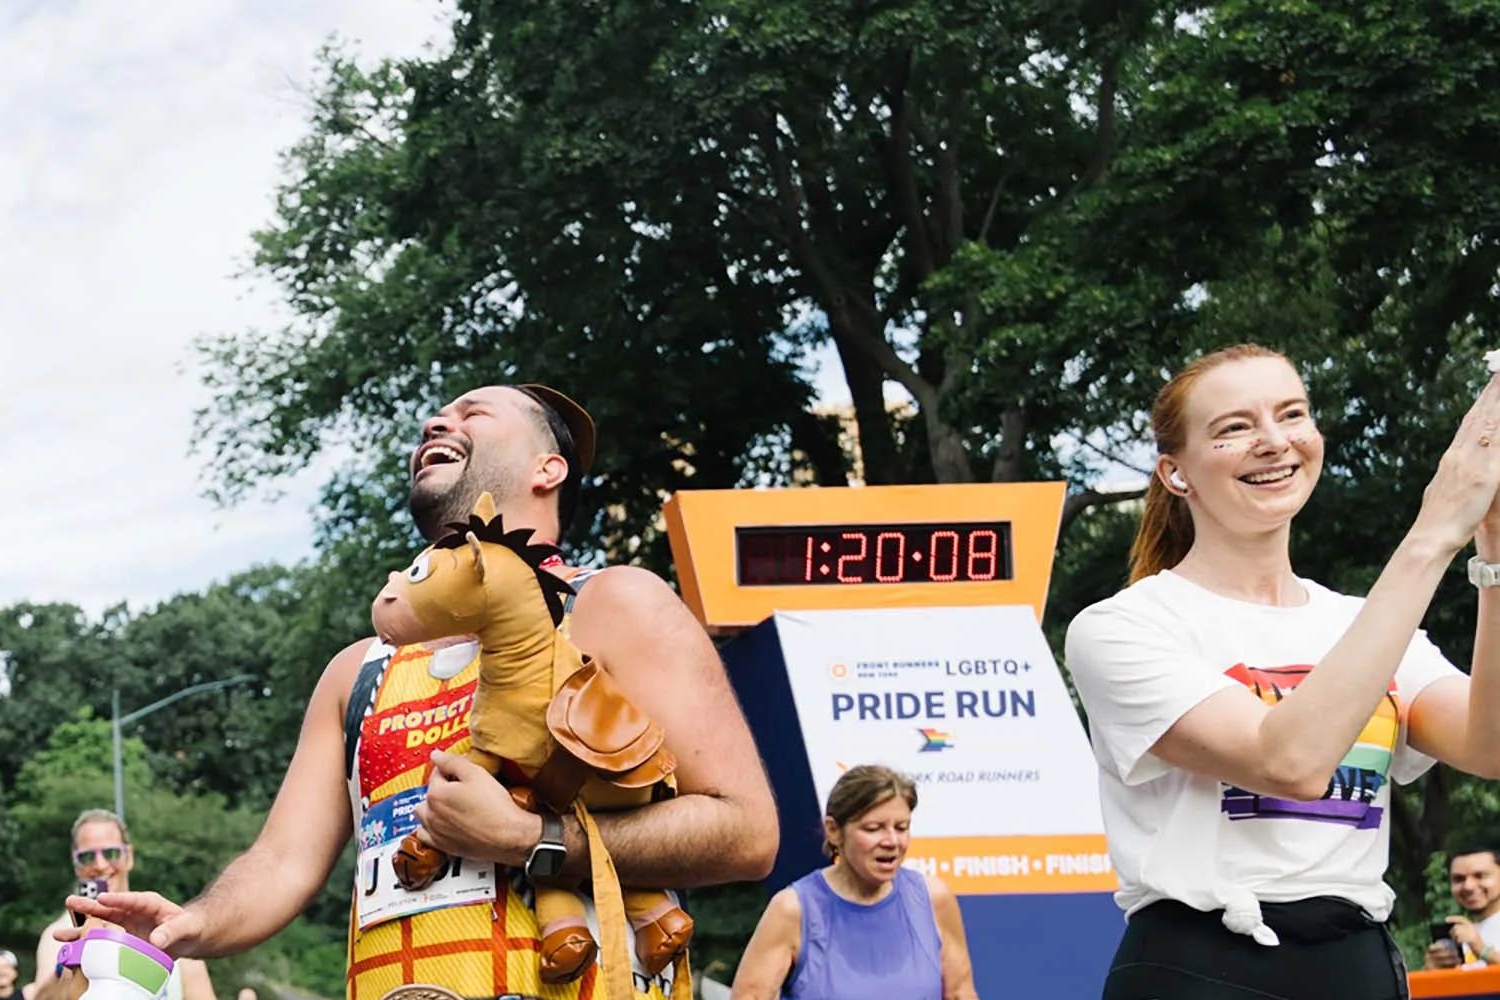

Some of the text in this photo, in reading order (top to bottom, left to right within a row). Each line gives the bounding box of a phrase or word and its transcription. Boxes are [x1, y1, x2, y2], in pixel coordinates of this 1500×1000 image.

[945, 660, 1032, 676] LGBTQ+
[378, 694, 470, 736] PROTECT
[831, 690, 1036, 721] PRIDE RUN
[979, 769, 1041, 782] RUNNERS
[364, 857, 380, 897] J
[953, 855, 1030, 877] FINISH
